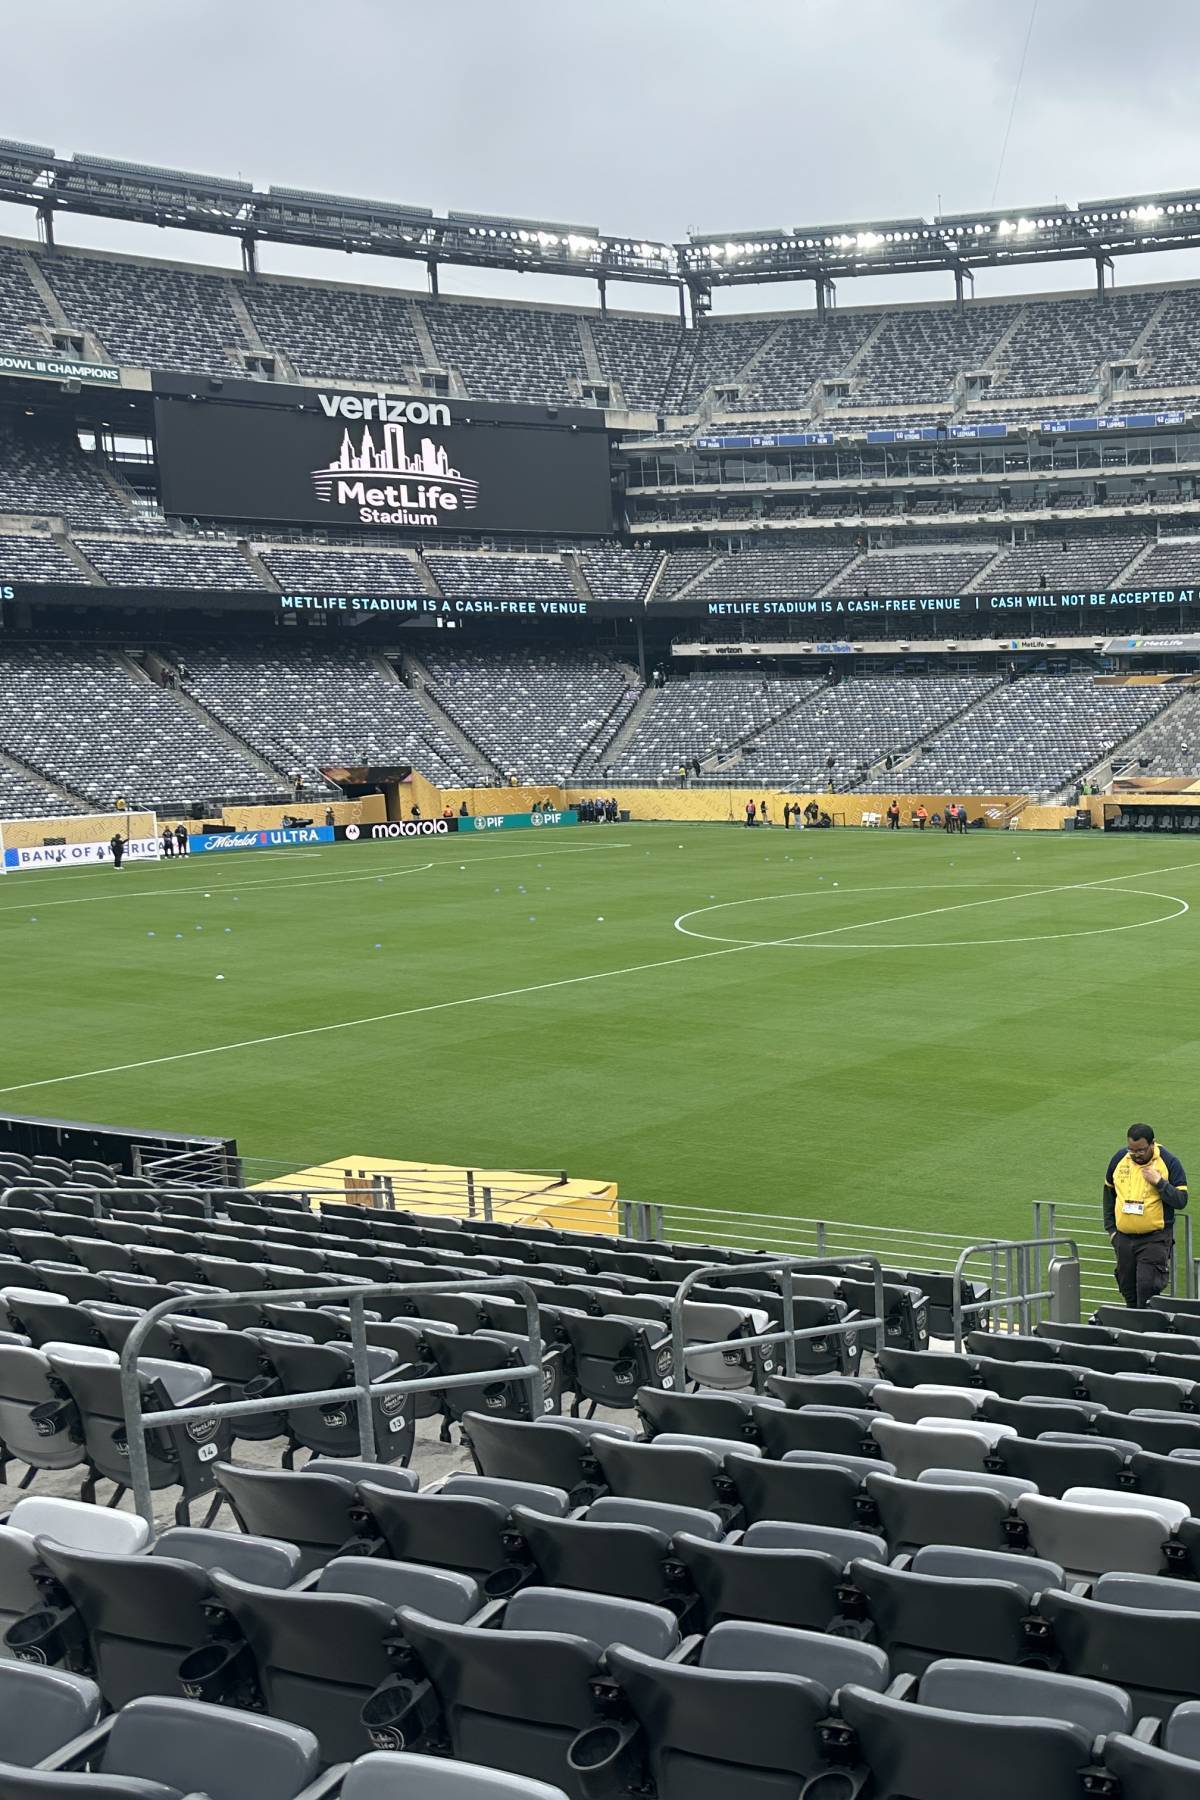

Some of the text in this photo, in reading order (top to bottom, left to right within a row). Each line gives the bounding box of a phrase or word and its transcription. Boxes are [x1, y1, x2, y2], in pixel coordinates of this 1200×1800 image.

[47, 363, 118, 379] CHAMPIONS
[318, 393, 451, 426] verizon
[338, 480, 458, 510] MetLife
[360, 507, 438, 525] Stadium
[281, 596, 587, 614] METLIFE STADIUM IS A CASH-FREE VENUE
[708, 602, 760, 614] METLIFE
[763, 601, 817, 613] STADIUM
[821, 601, 833, 612] IS
[836, 601, 844, 612] A
[847, 600, 917, 612] CASH-FREE
[919, 598, 961, 610] VENUE
[990, 596, 1022, 608] CASH
[1026, 595, 1057, 607] WILL
[1061, 594, 1085, 606] NOT
[1090, 594, 1106, 605] BE
[1110, 591, 1175, 604] ACCEPTED
[1179, 590, 1194, 601] AT
[715, 646, 743, 654] verizon
[1021, 640, 1045, 648] MetLife
[487, 816, 504, 827] PIF
[544, 813, 561, 824] PIF
[372, 819, 448, 839] motorola
[204, 829, 319, 850] Michelob ULTRA
[22, 848, 67, 862] BANK
[71, 846, 91, 858] OF
[201, 1445, 214, 1458] 14
